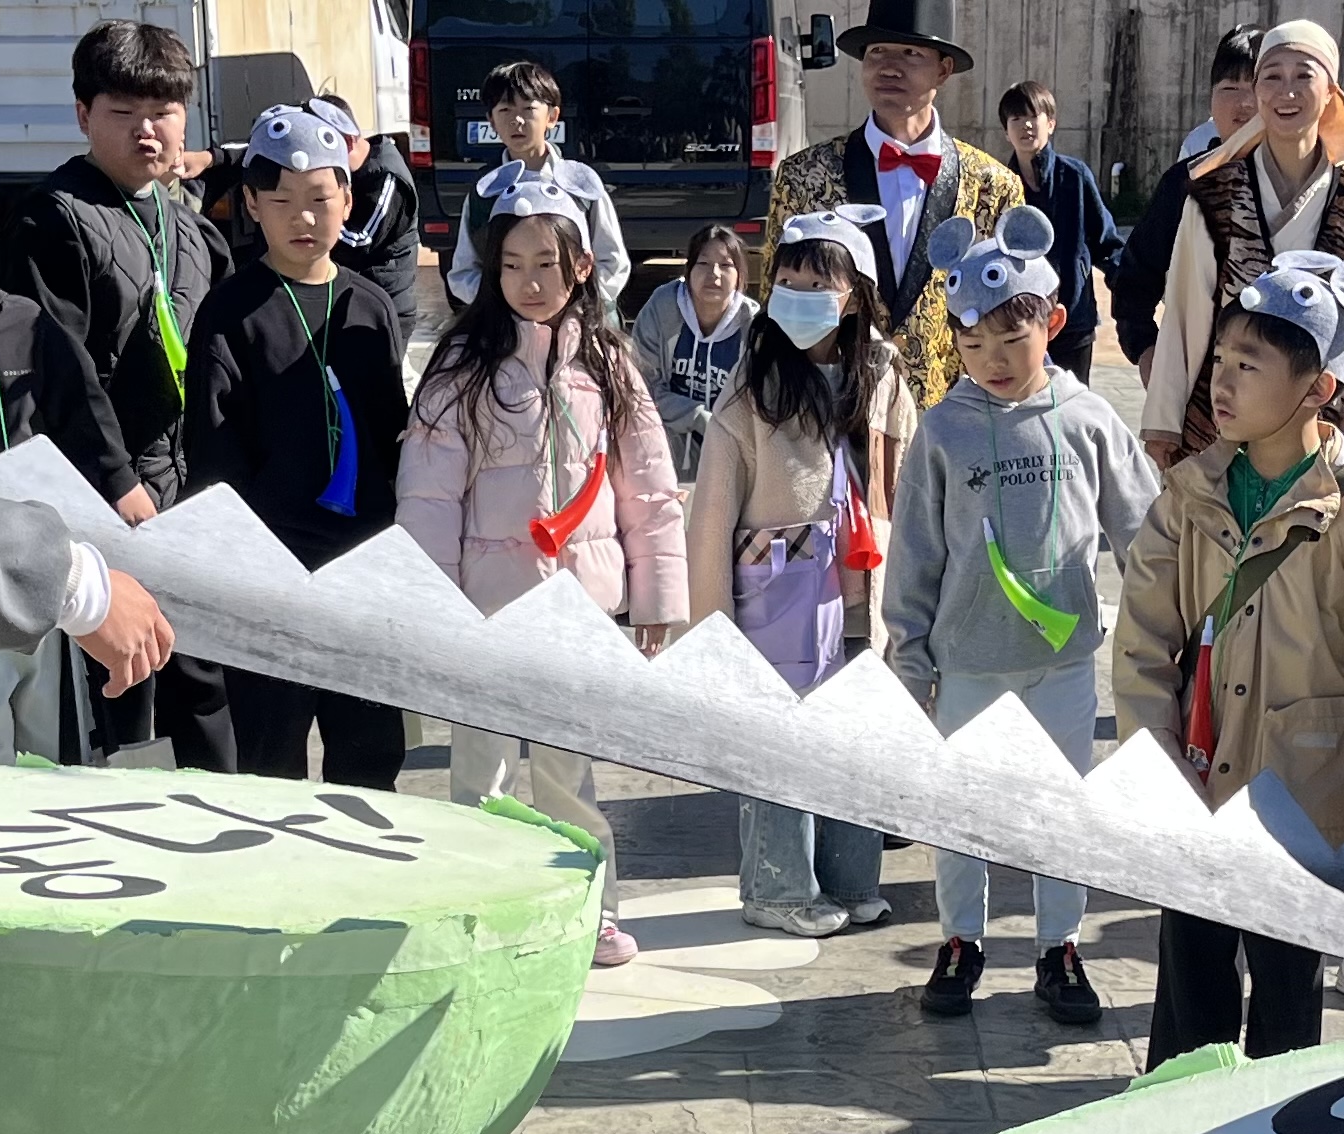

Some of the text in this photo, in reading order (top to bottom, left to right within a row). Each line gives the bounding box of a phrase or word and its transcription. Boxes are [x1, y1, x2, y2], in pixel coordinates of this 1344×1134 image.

[683, 143, 741, 153] SOLATI
[992, 453, 1080, 473] BEVERLY HILLS
[999, 469, 1074, 488] POLO CLUB
